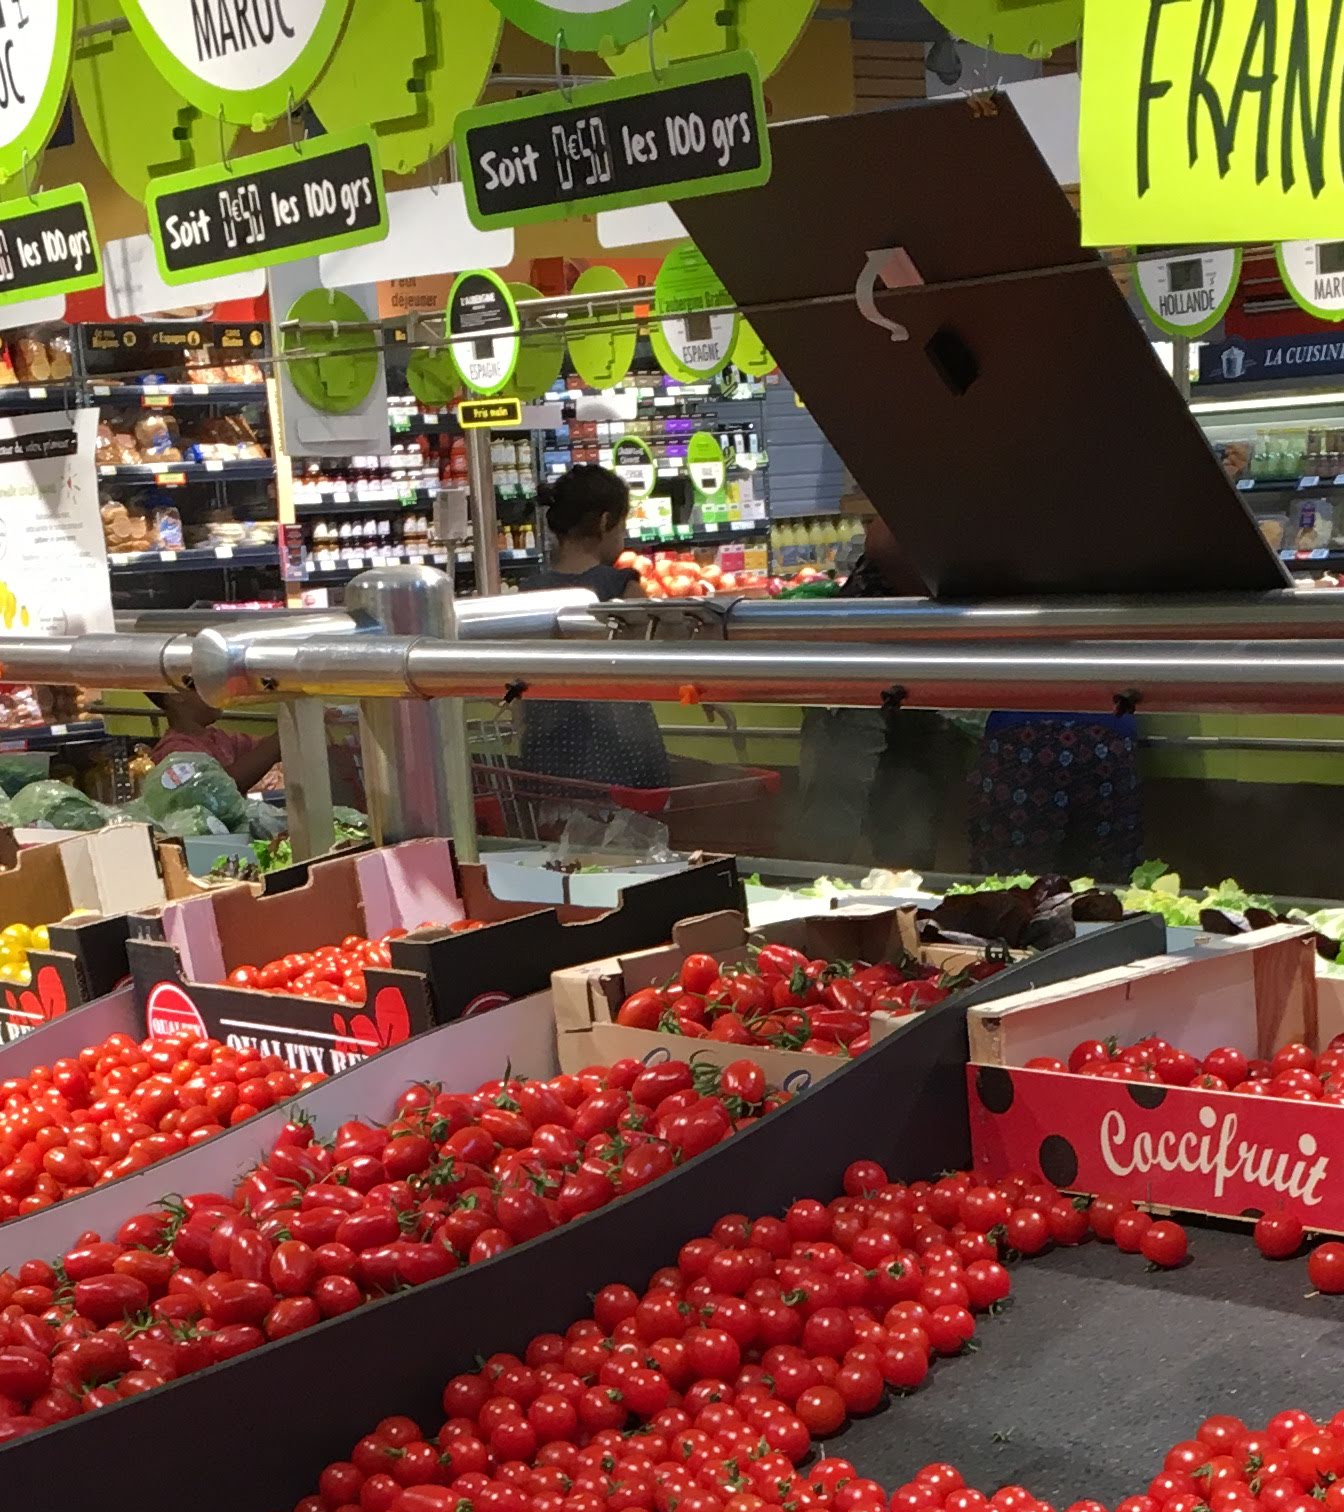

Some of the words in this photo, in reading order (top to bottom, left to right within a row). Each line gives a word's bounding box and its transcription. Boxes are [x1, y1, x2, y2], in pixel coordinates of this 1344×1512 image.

[191, 0, 295, 61] MAROC
[480, 145, 539, 190] Soit
[622, 125, 657, 166] les
[665, 113, 705, 156] 100
[712, 111, 751, 167] grs
[165, 209, 211, 250] Soit
[271, 191, 300, 227] les
[304, 179, 336, 218] 100
[340, 177, 372, 226] grs
[16, 237, 42, 268] les
[41, 228, 68, 263] 100
[68, 230, 91, 272] grs
[1159, 289, 1215, 317] HOLLANDE
[469, 361, 502, 380] ESPAGNE
[682, 343, 721, 363] ESPAGNE
[1264, 349, 1283, 366] LA
[1100, 1106, 1330, 1206] Coccifruit
